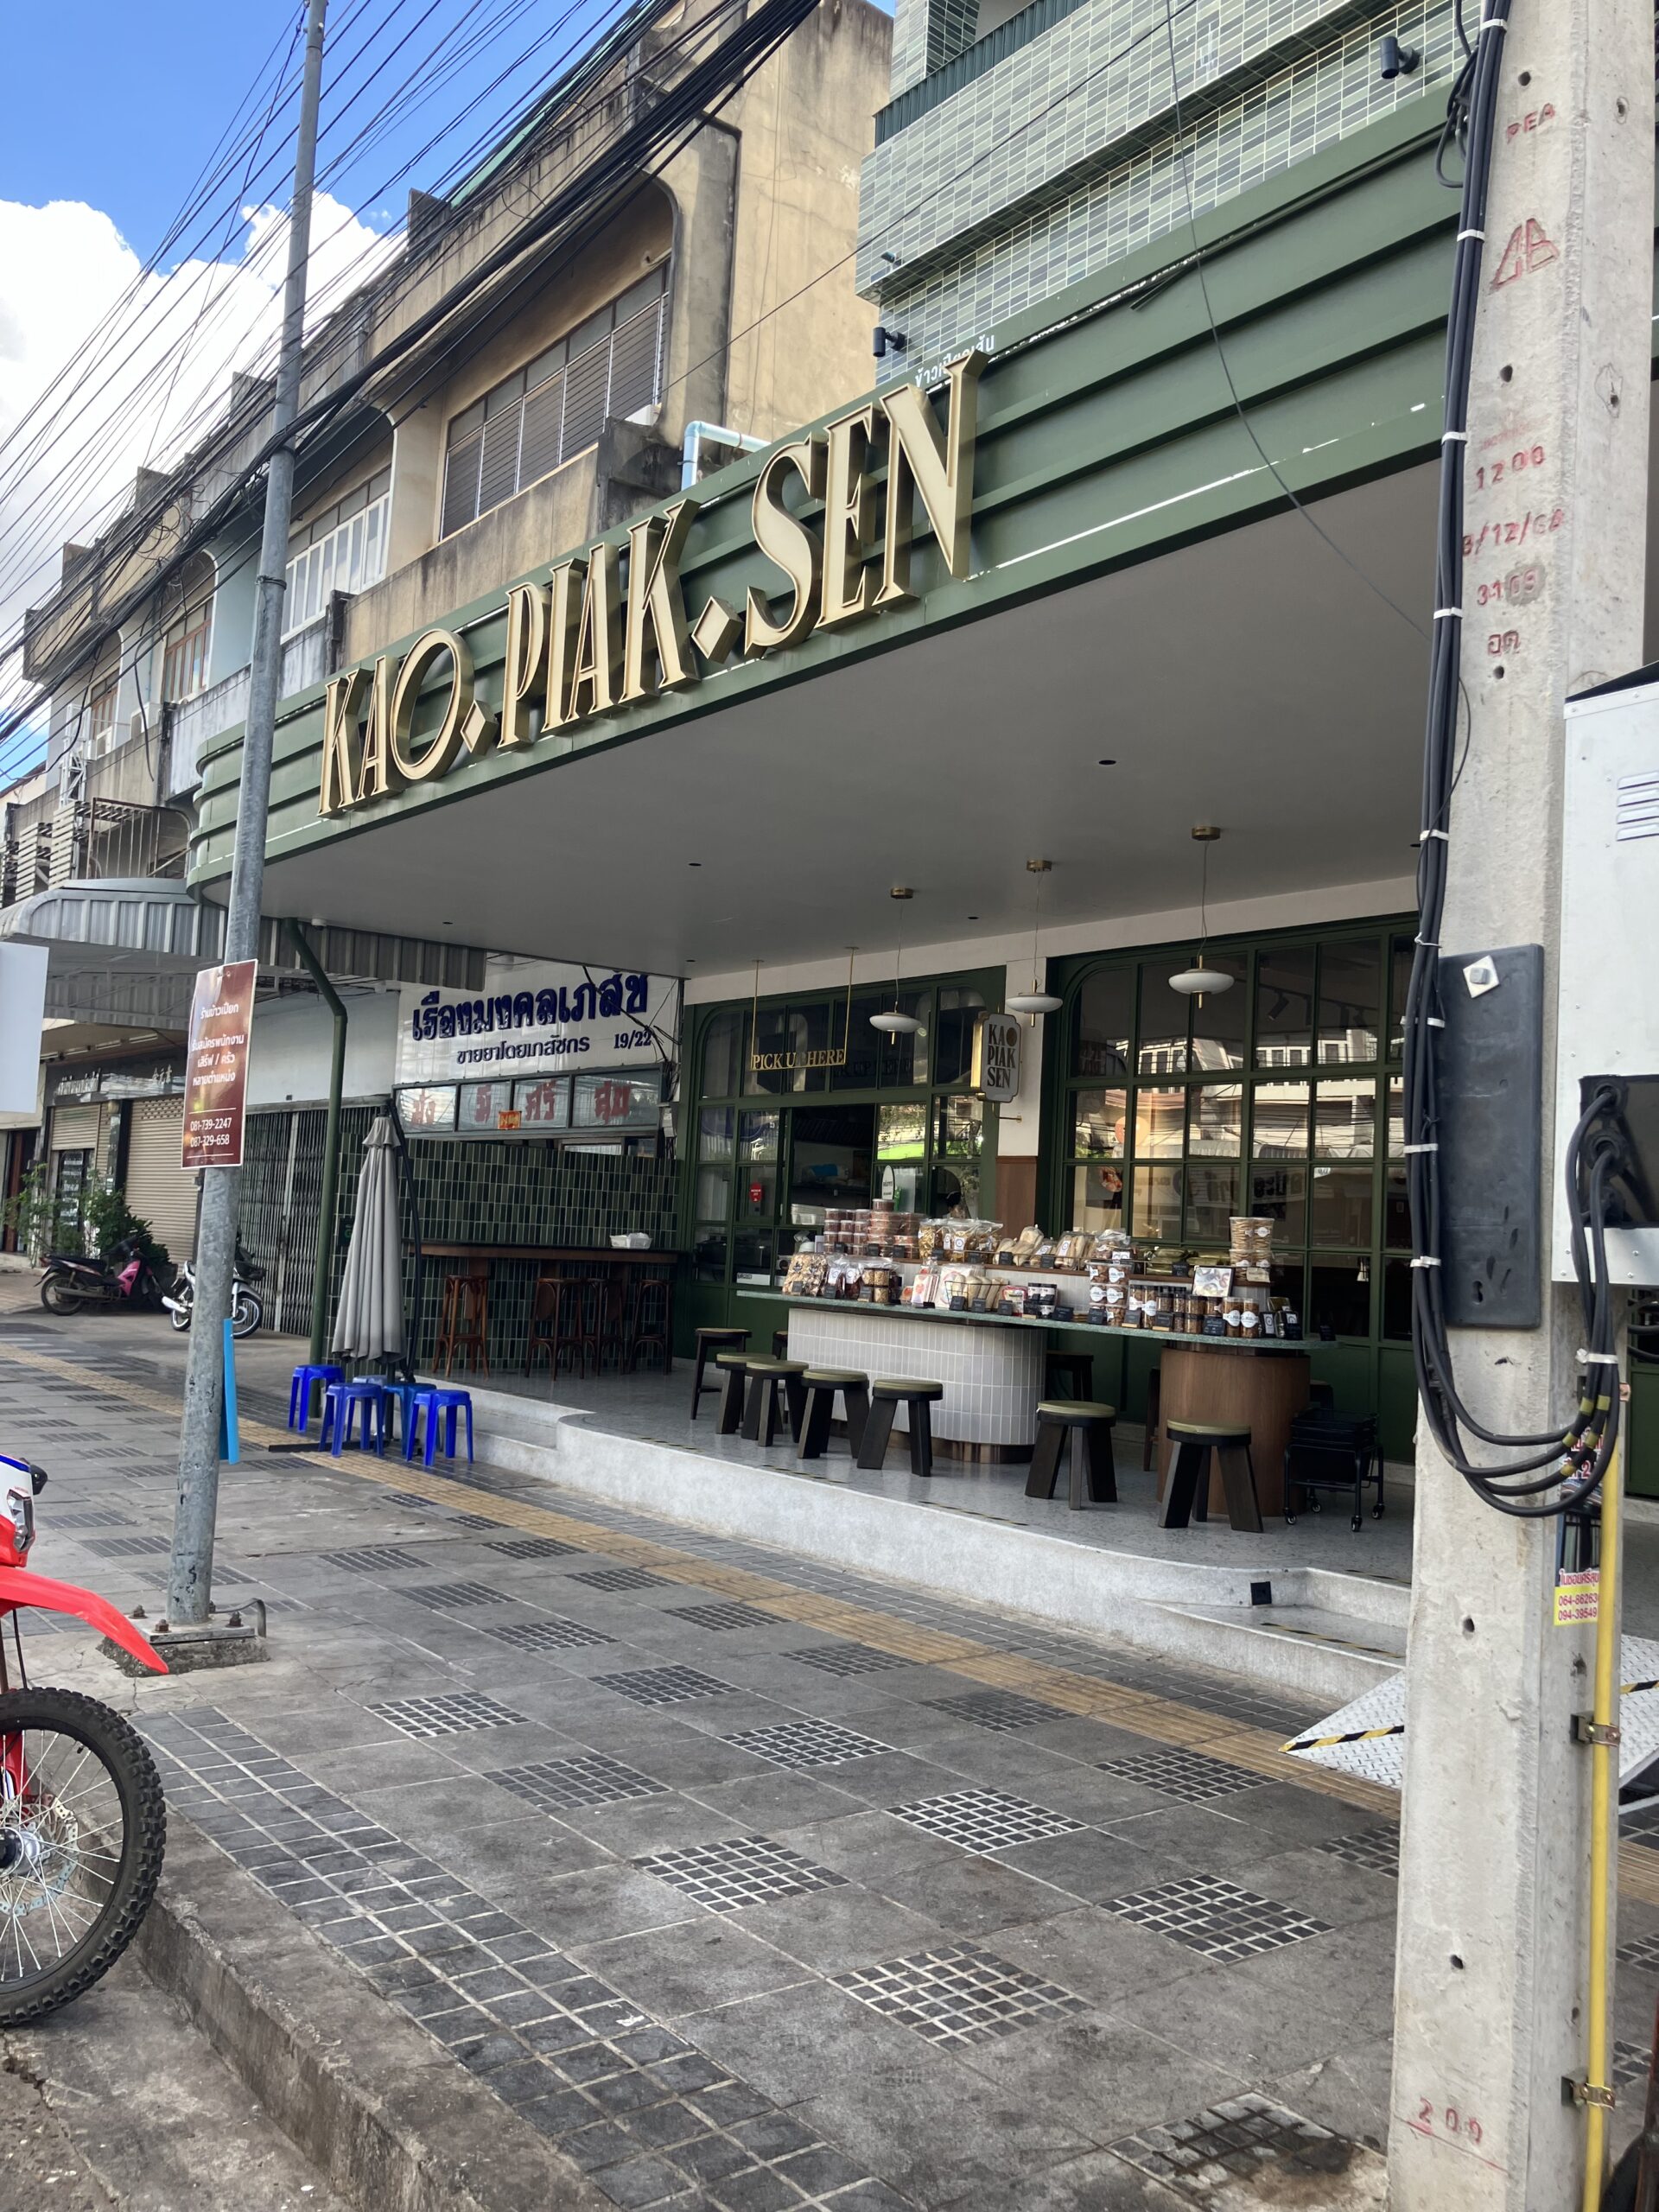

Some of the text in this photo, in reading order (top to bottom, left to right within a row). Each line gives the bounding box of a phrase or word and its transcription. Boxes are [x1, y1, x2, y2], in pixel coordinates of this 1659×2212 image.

[1506, 103, 1554, 143] PEA
[1476, 445, 1544, 490] 1200
[745, 350, 988, 658] SEN
[412, 971, 648, 1041] เรืองมงคลเภสช
[192, 1033, 245, 1052] รับสมัครพนักงาน
[614, 1030, 652, 1050] 19/22
[752, 1052, 783, 1070] PICK
[806, 1048, 845, 1066] HERE
[987, 1046, 1016, 1069] PIAK
[987, 1066, 1011, 1089] SEN
[189, 1117, 232, 1132] 081-739-2247
